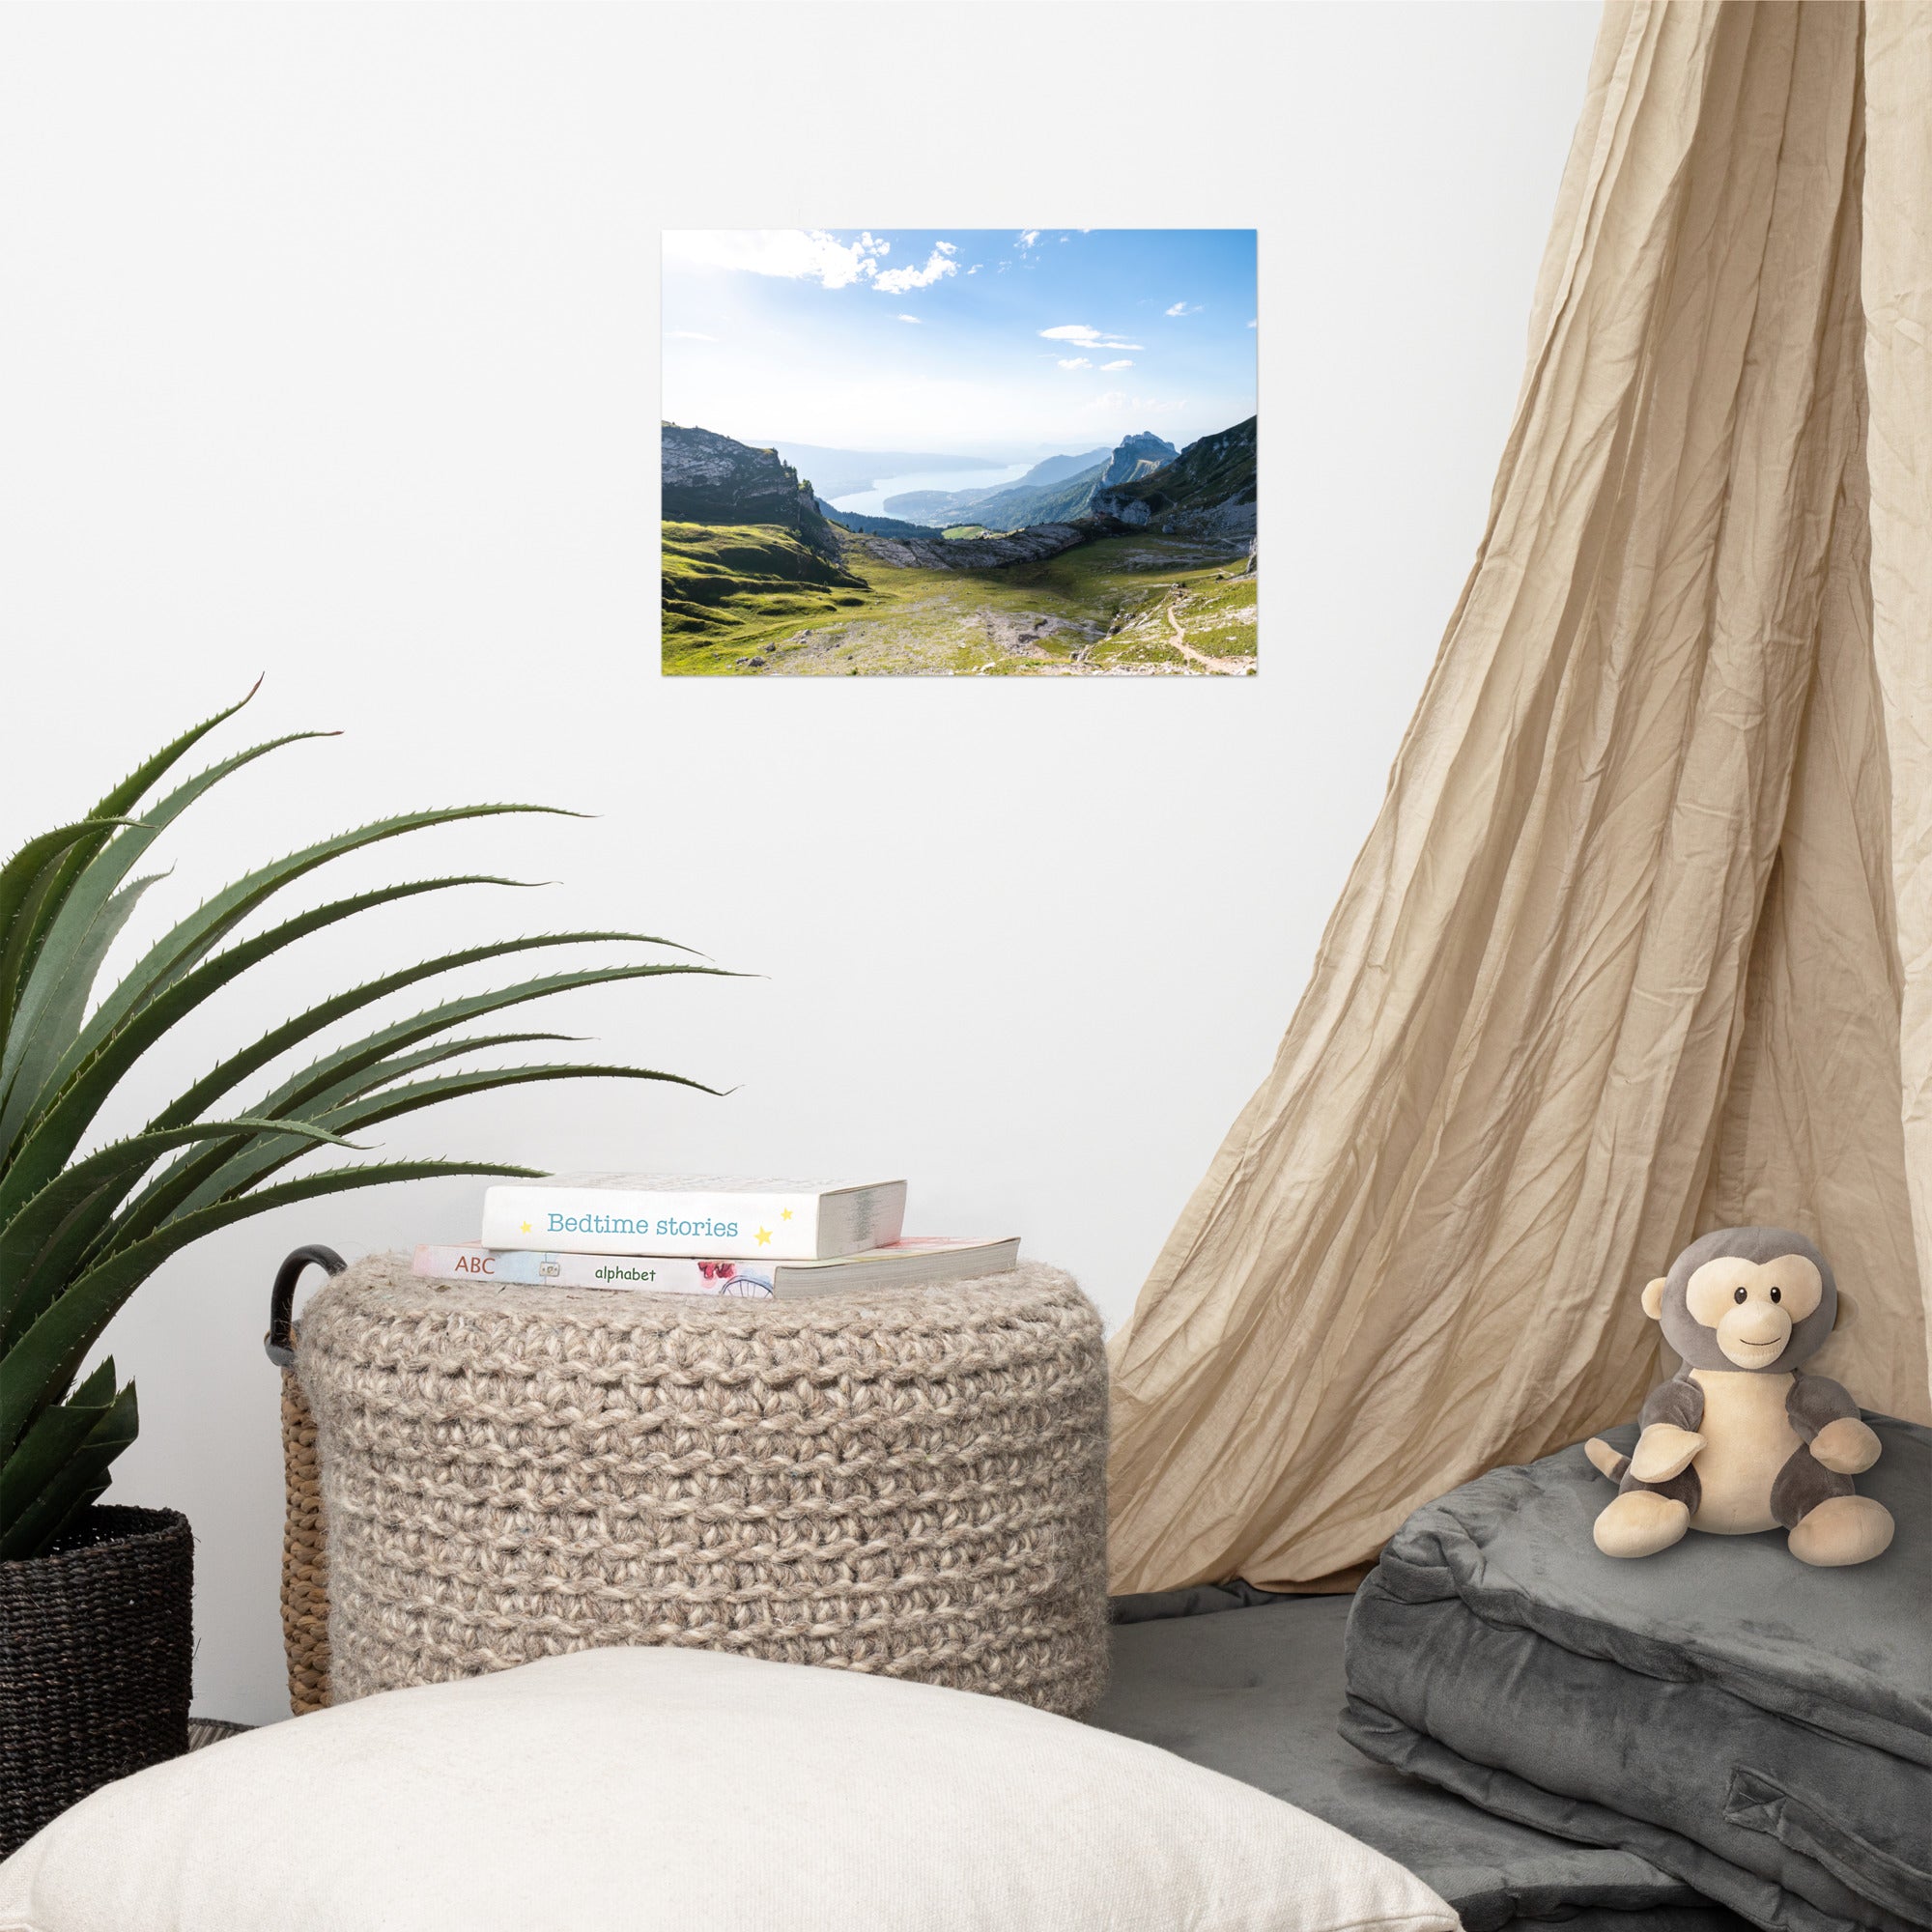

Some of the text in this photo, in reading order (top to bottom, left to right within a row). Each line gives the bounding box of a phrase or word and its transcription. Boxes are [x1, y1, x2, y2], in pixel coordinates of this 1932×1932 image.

[548, 1212, 739, 1237] Bedtime stories
[454, 1255, 657, 1284] ABC alphabet
